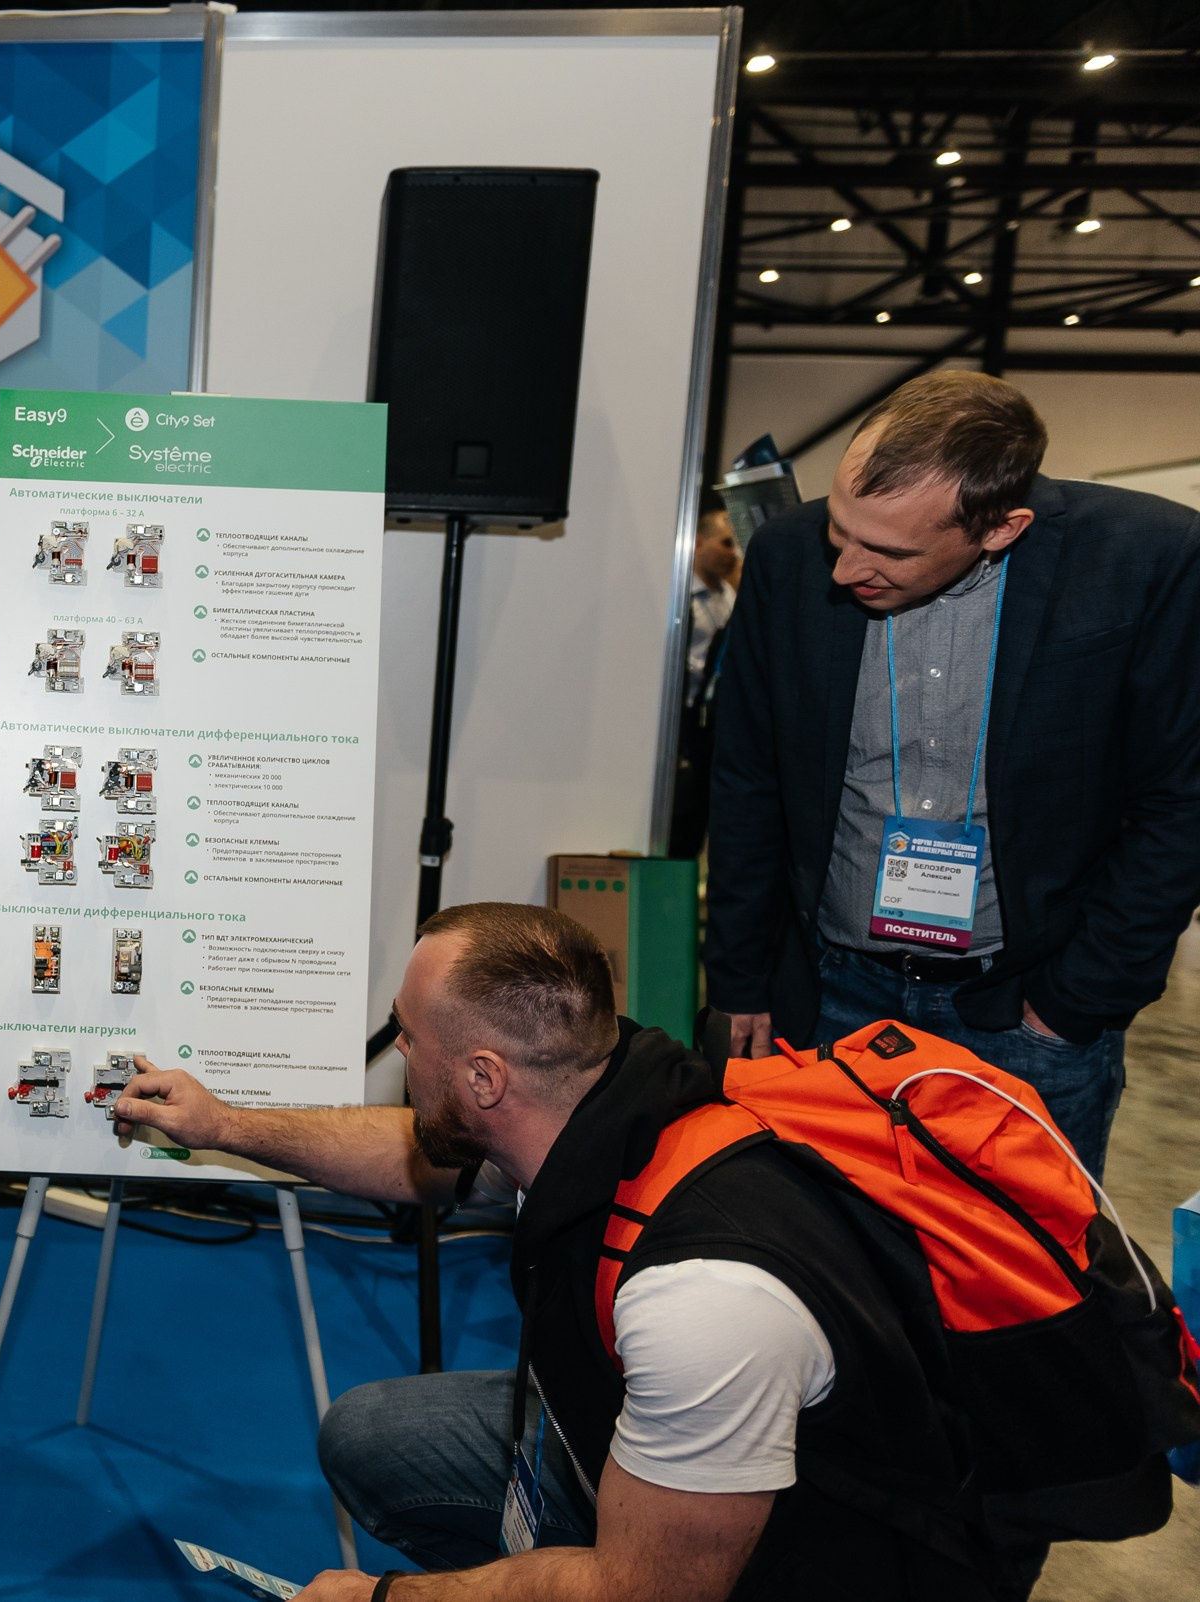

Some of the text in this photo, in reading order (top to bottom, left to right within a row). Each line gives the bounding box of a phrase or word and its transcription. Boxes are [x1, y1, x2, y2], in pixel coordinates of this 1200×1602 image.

[15, 406, 67, 426] Easy9
[156, 414, 215, 428] City9 Set
[12, 444, 86, 460] Schneider
[44, 458, 85, 468] Electric
[155, 461, 211, 474] electric
[9, 488, 202, 504] Автоматические выключатели
[59, 507, 110, 517] платформа
[126, 509, 136, 517] 32
[254, 571, 318, 579] ДУГОГАСИТЕЛЬНАЯ
[53, 614, 103, 623] платформа
[105, 615, 116, 623] 40
[124, 616, 135, 624] 63
[0, 721, 359, 743] Автоматические выключатели дифференциального тока
[206, 799, 269, 807] ТЕПЛООТВОДЯЩИЕ
[212, 847, 262, 855] Предотвращает
[921, 872, 952, 880] Алексей
[83, 907, 214, 920] дифференциального
[217, 913, 245, 921] тока
[885, 924, 957, 942] ПОСЕТИТЕЛЬ
[206, 995, 257, 1003] Предотвращает
[79, 1026, 136, 1037] нагрузки
